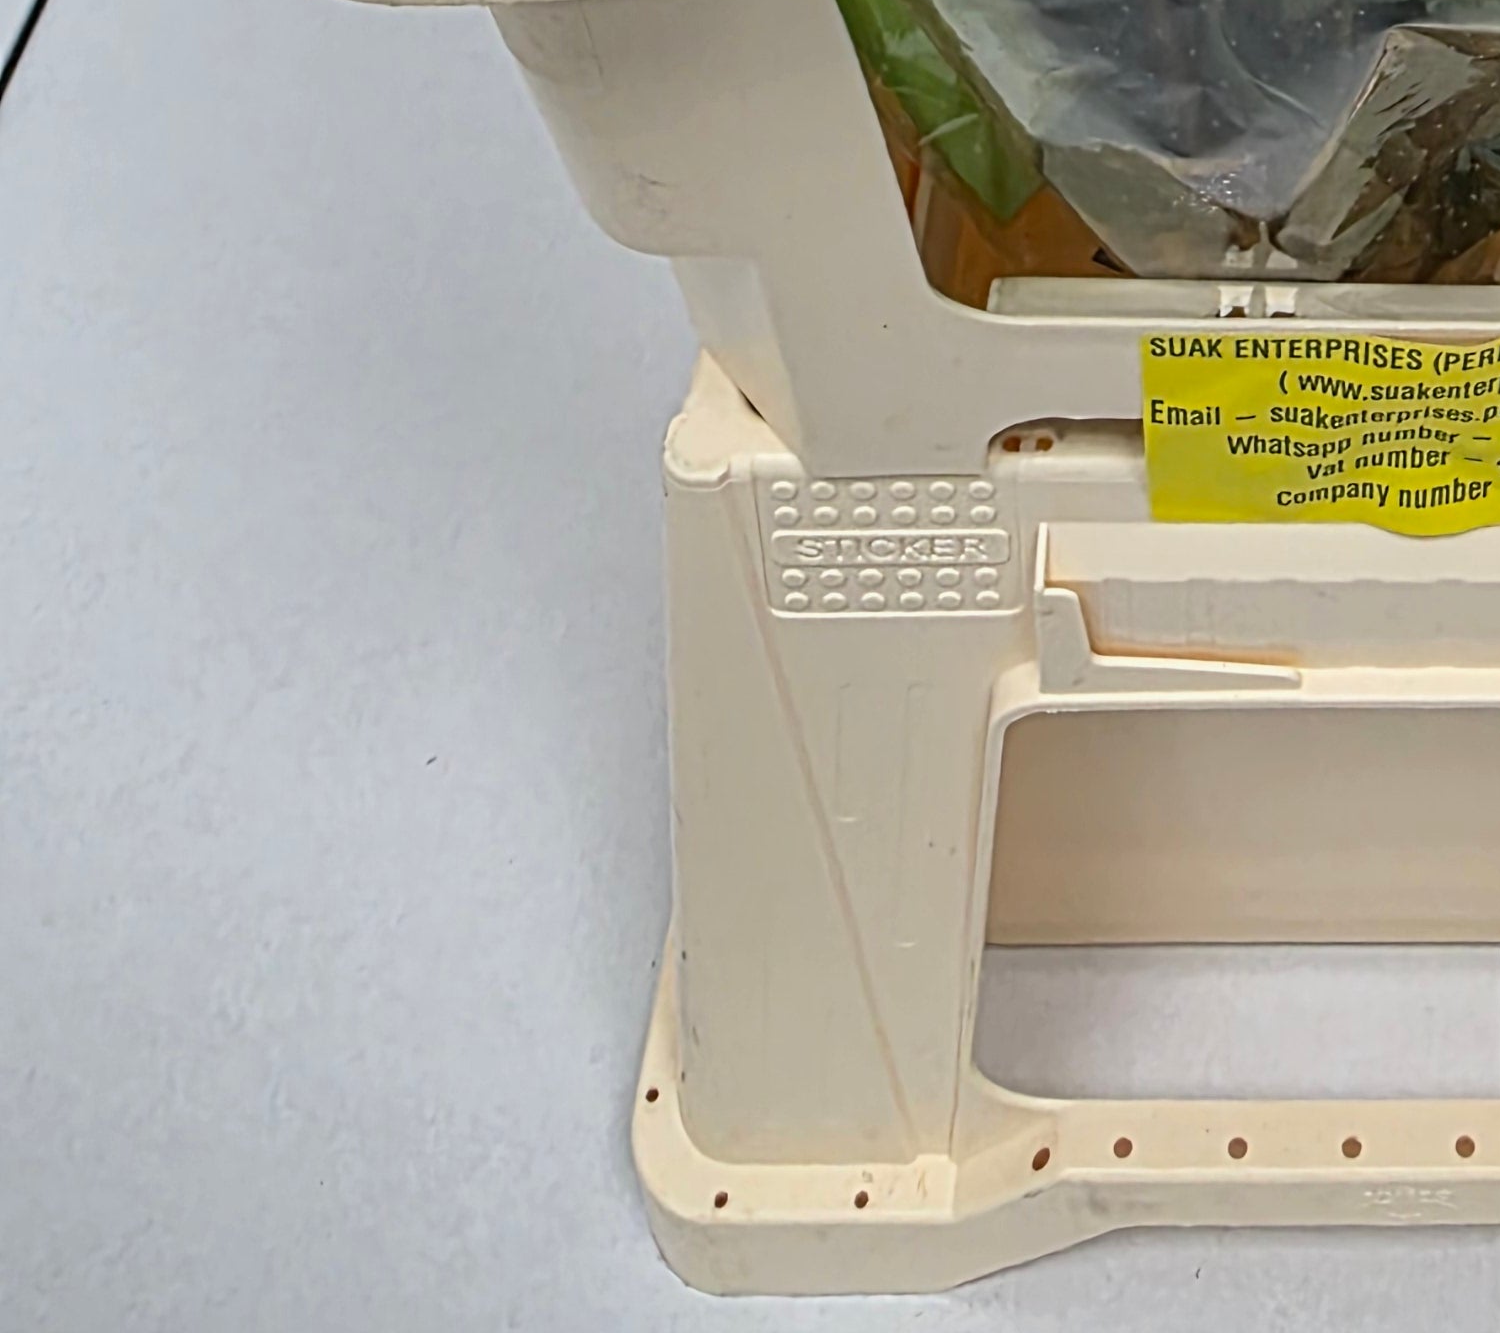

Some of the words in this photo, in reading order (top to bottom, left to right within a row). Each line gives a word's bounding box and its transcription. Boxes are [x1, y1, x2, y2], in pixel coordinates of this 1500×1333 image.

[1150, 336, 1223, 359] SUAK
[1235, 338, 1424, 370] ENTERPRISES
[1150, 399, 1222, 427] Email
[1227, 434, 1352, 459] Whatsapp
[1362, 425, 1460, 446] number
[1307, 459, 1345, 480] Vat
[1355, 447, 1451, 470] number
[1276, 481, 1391, 509] Company
[1398, 477, 1494, 510] number
[796, 537, 990, 562] STICKER
